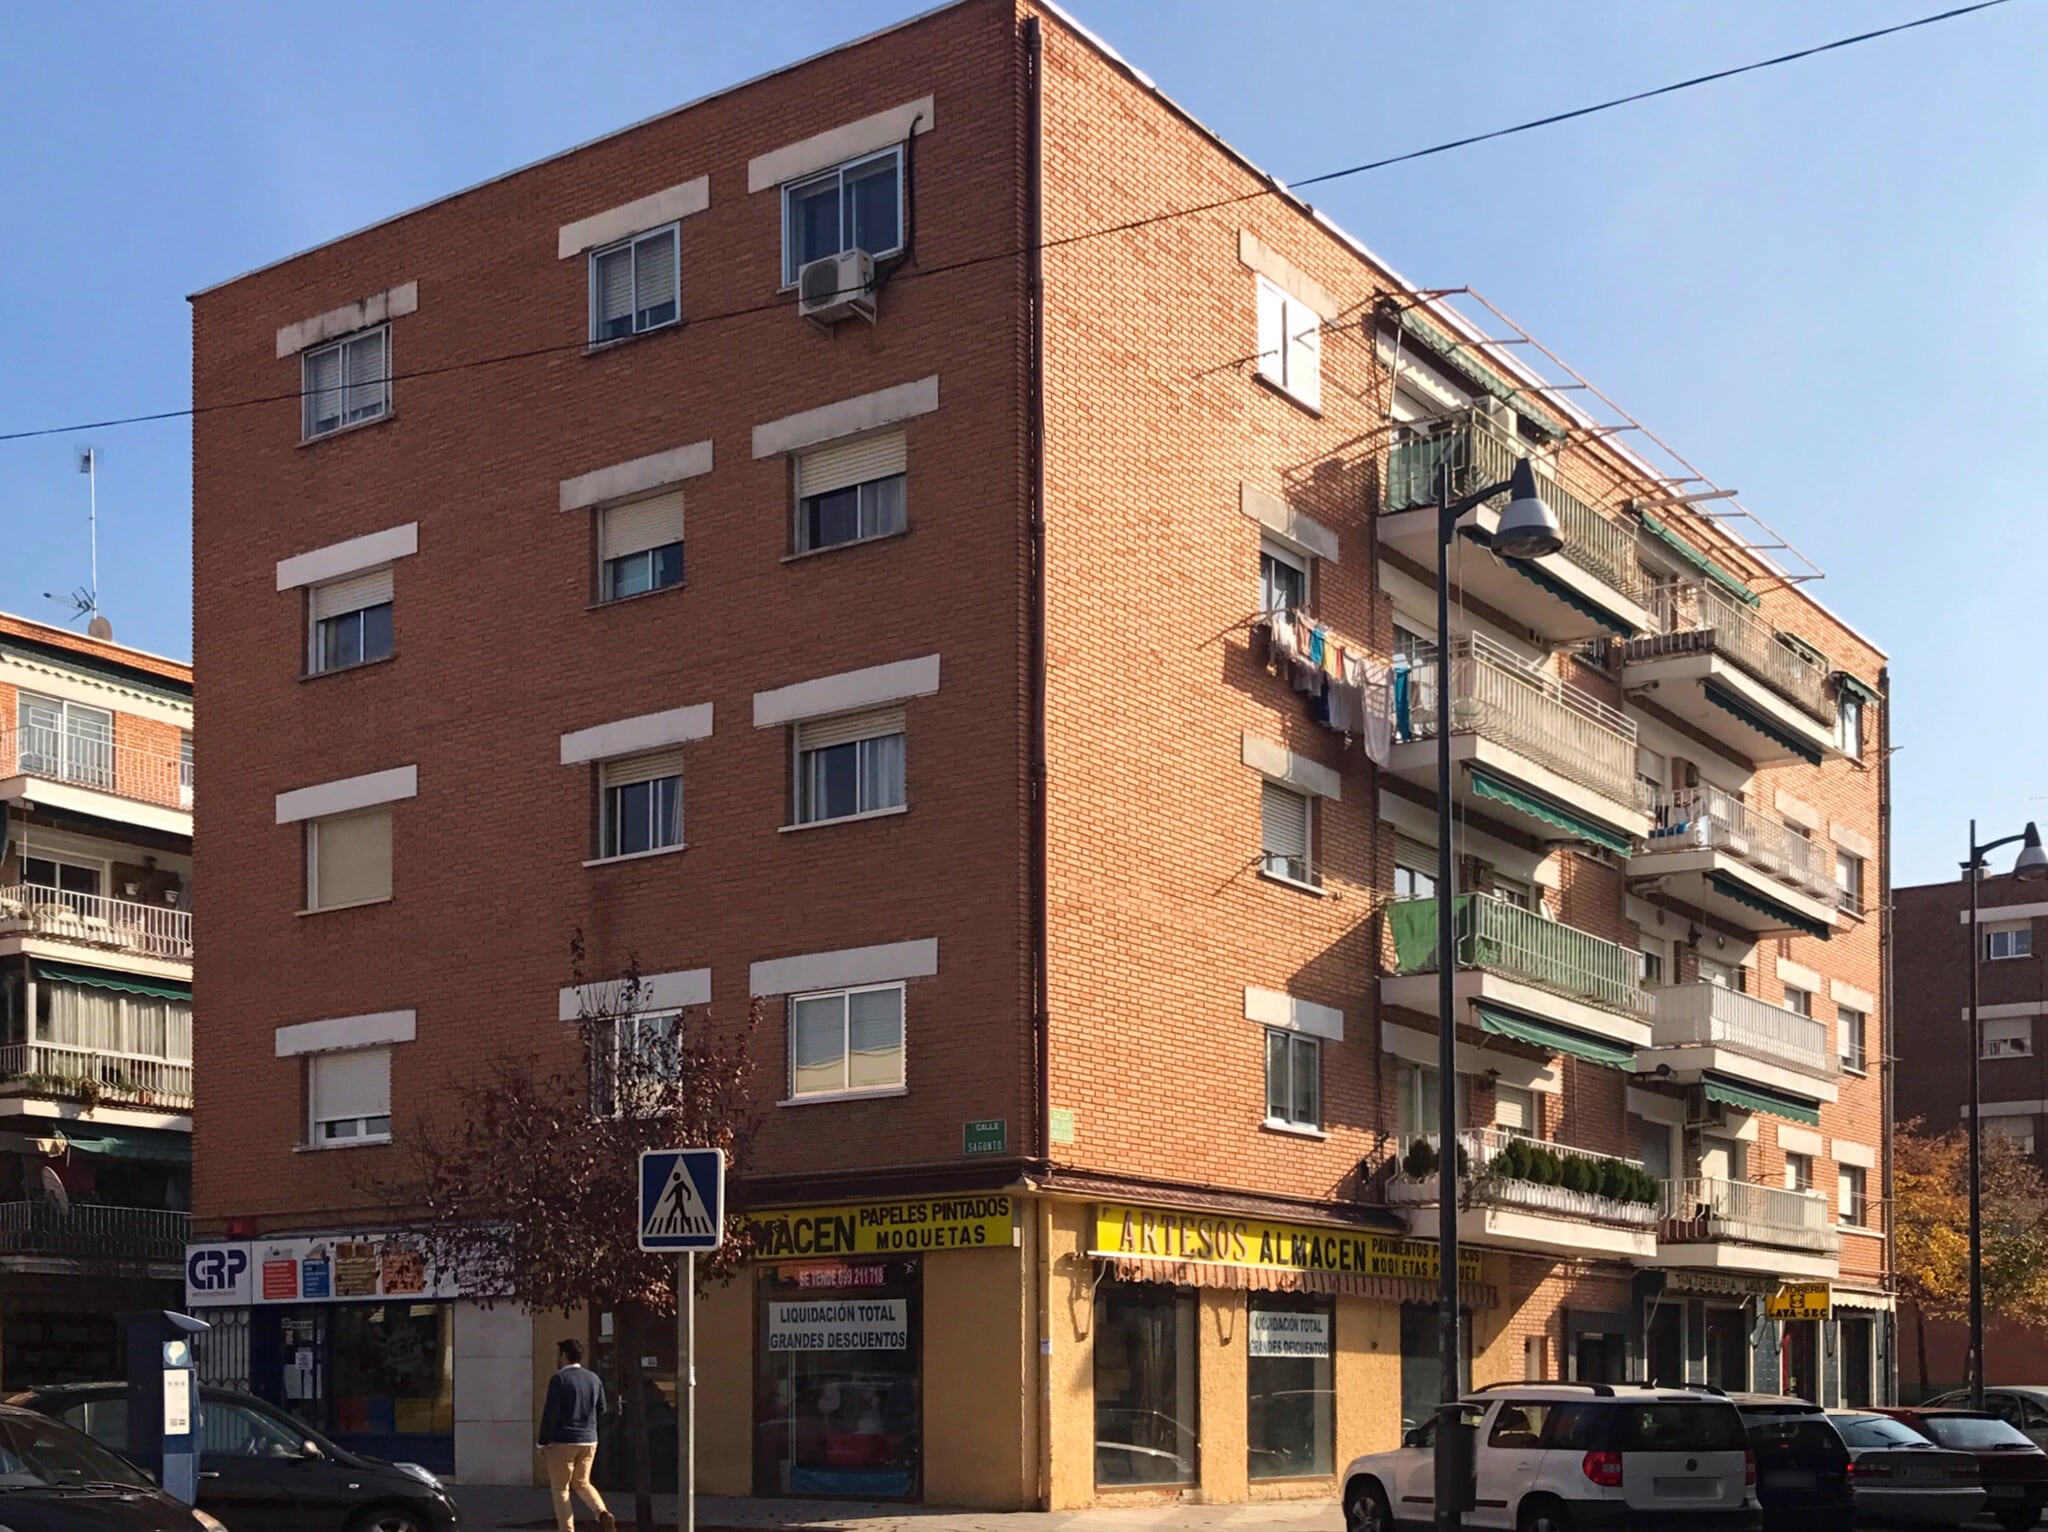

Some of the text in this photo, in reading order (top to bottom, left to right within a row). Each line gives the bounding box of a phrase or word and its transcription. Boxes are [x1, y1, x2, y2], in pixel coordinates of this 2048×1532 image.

[976, 1123, 999, 1131] CALLE
[968, 1141, 1003, 1152] SAGUNTO
[860, 1197, 1009, 1227] PAPELES PINTADOS
[750, 1216, 855, 1256] MACEN
[876, 1225, 986, 1250] MOQUETAS
[1119, 1210, 1367, 1272] ARTESOS ALMACEN
[1372, 1238, 1429, 1258] PAVIMENTOS
[1432, 1263, 1477, 1281] PUET
[780, 1303, 896, 1323] LIQUIDACIÓN TOTAL
[1300, 1317, 1323, 1333] TOTAL
[770, 1331, 906, 1350] GRANDES DESCUENTOS
